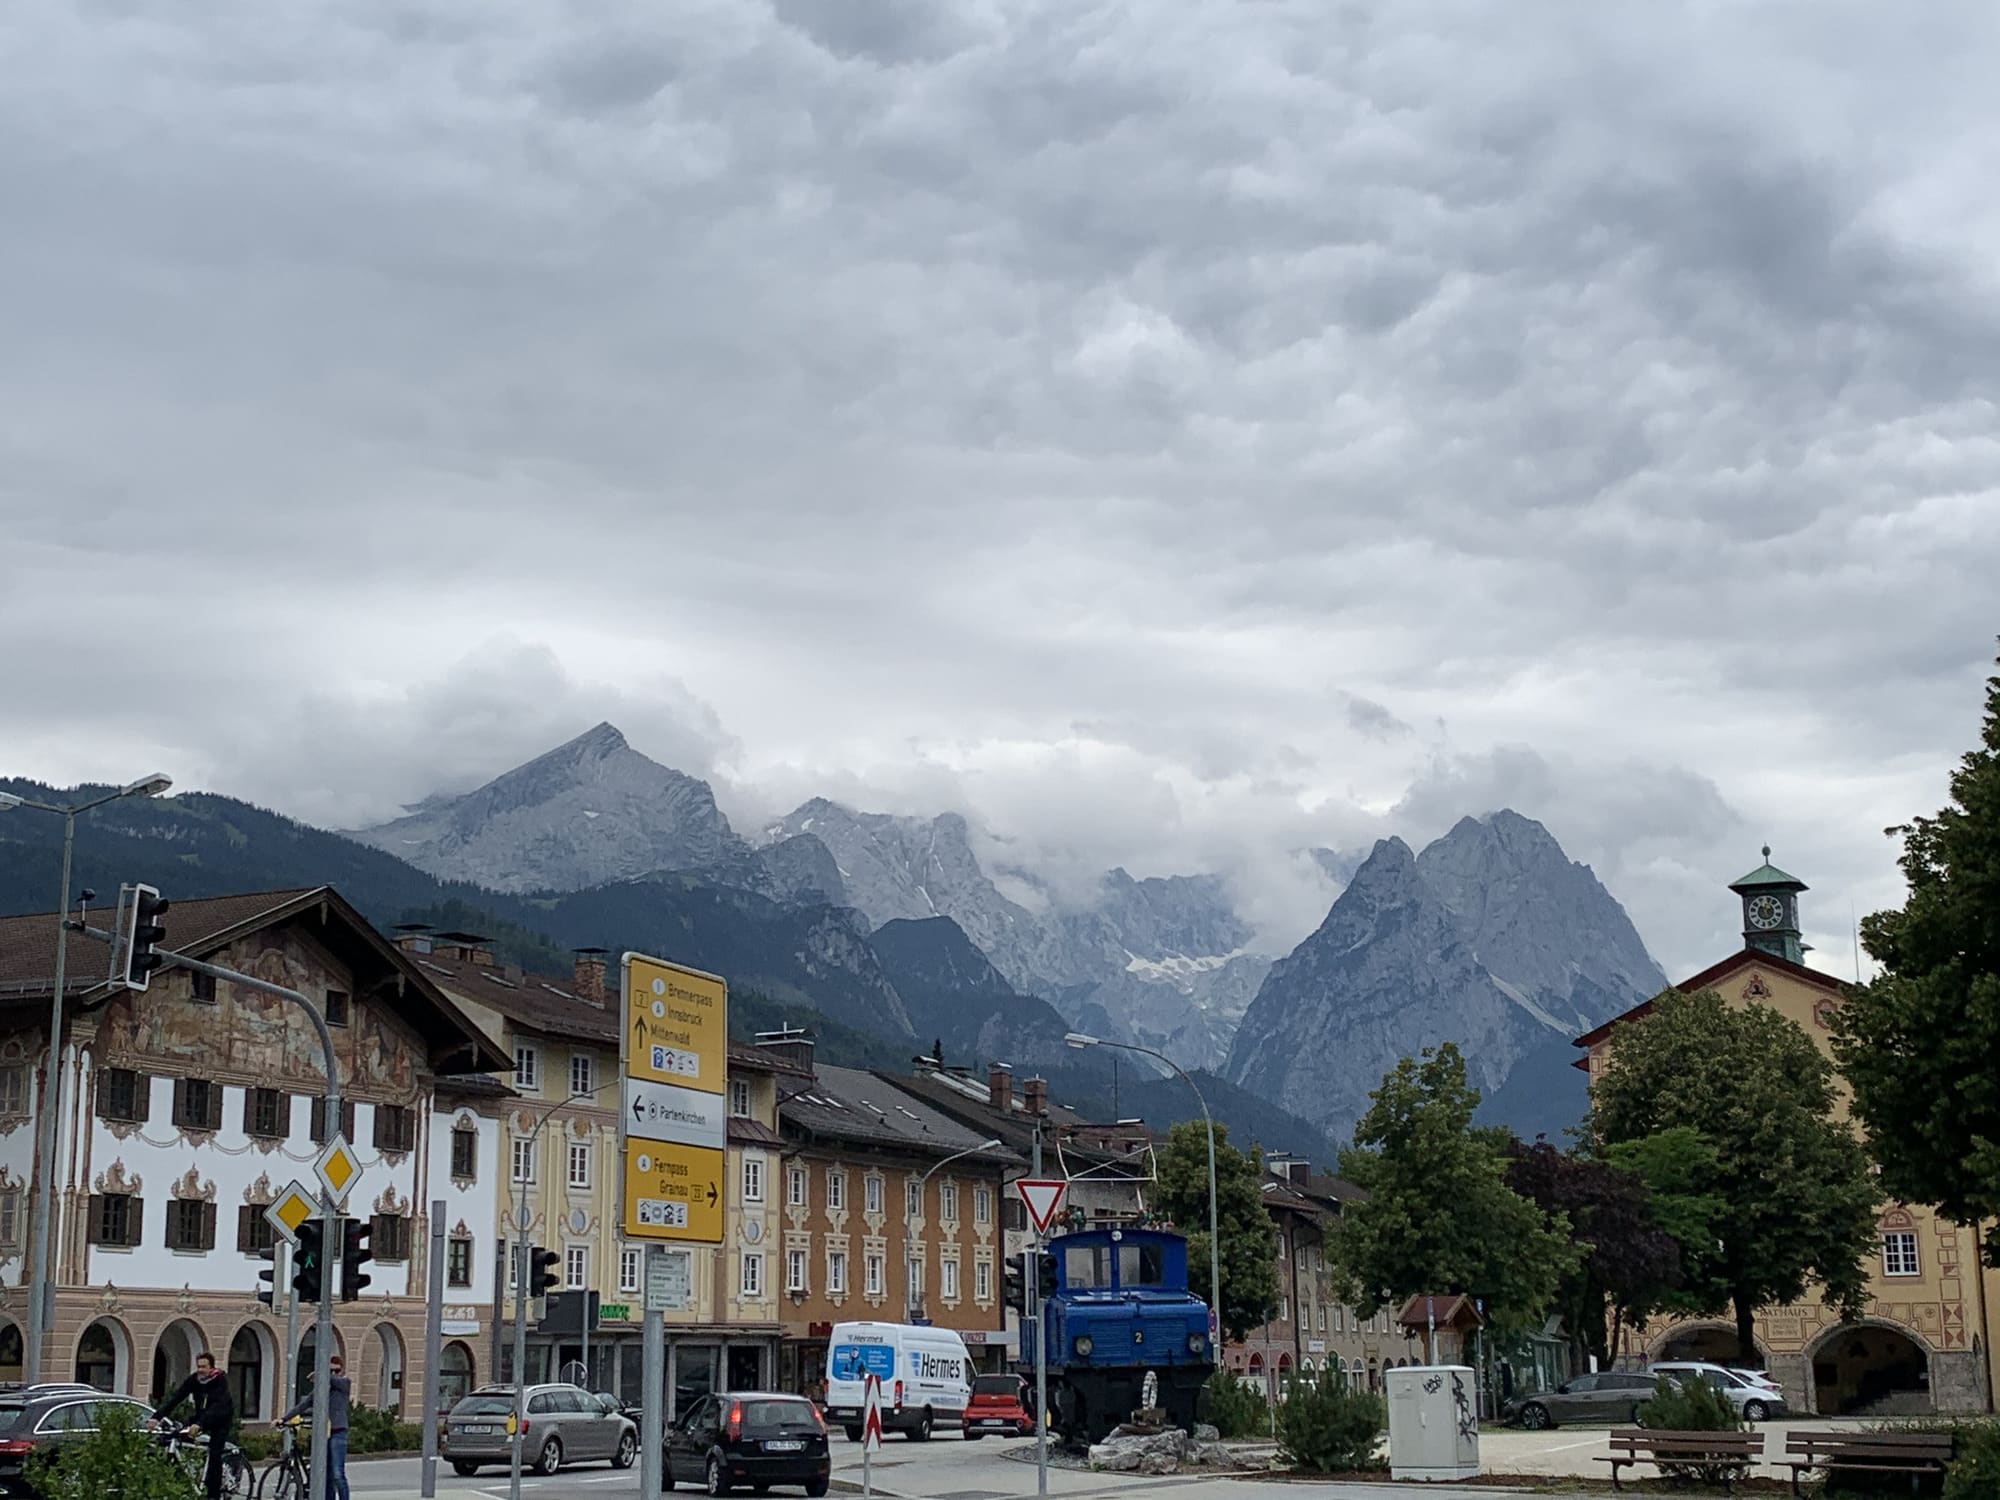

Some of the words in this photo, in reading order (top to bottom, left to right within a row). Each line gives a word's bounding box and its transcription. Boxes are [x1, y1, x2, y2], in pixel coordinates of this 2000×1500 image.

[668, 1004, 703, 1026] Innsbruck
[651, 1024, 690, 1045] Mittenwald
[660, 1105, 706, 1125] Partenkirchen
[654, 1157, 688, 1177] Fernpass
[659, 1179, 688, 1197] Grainau
[853, 1334, 884, 1343] Hermes
[1135, 1332, 1142, 1343] 2
[921, 1353, 960, 1378] Hermes
